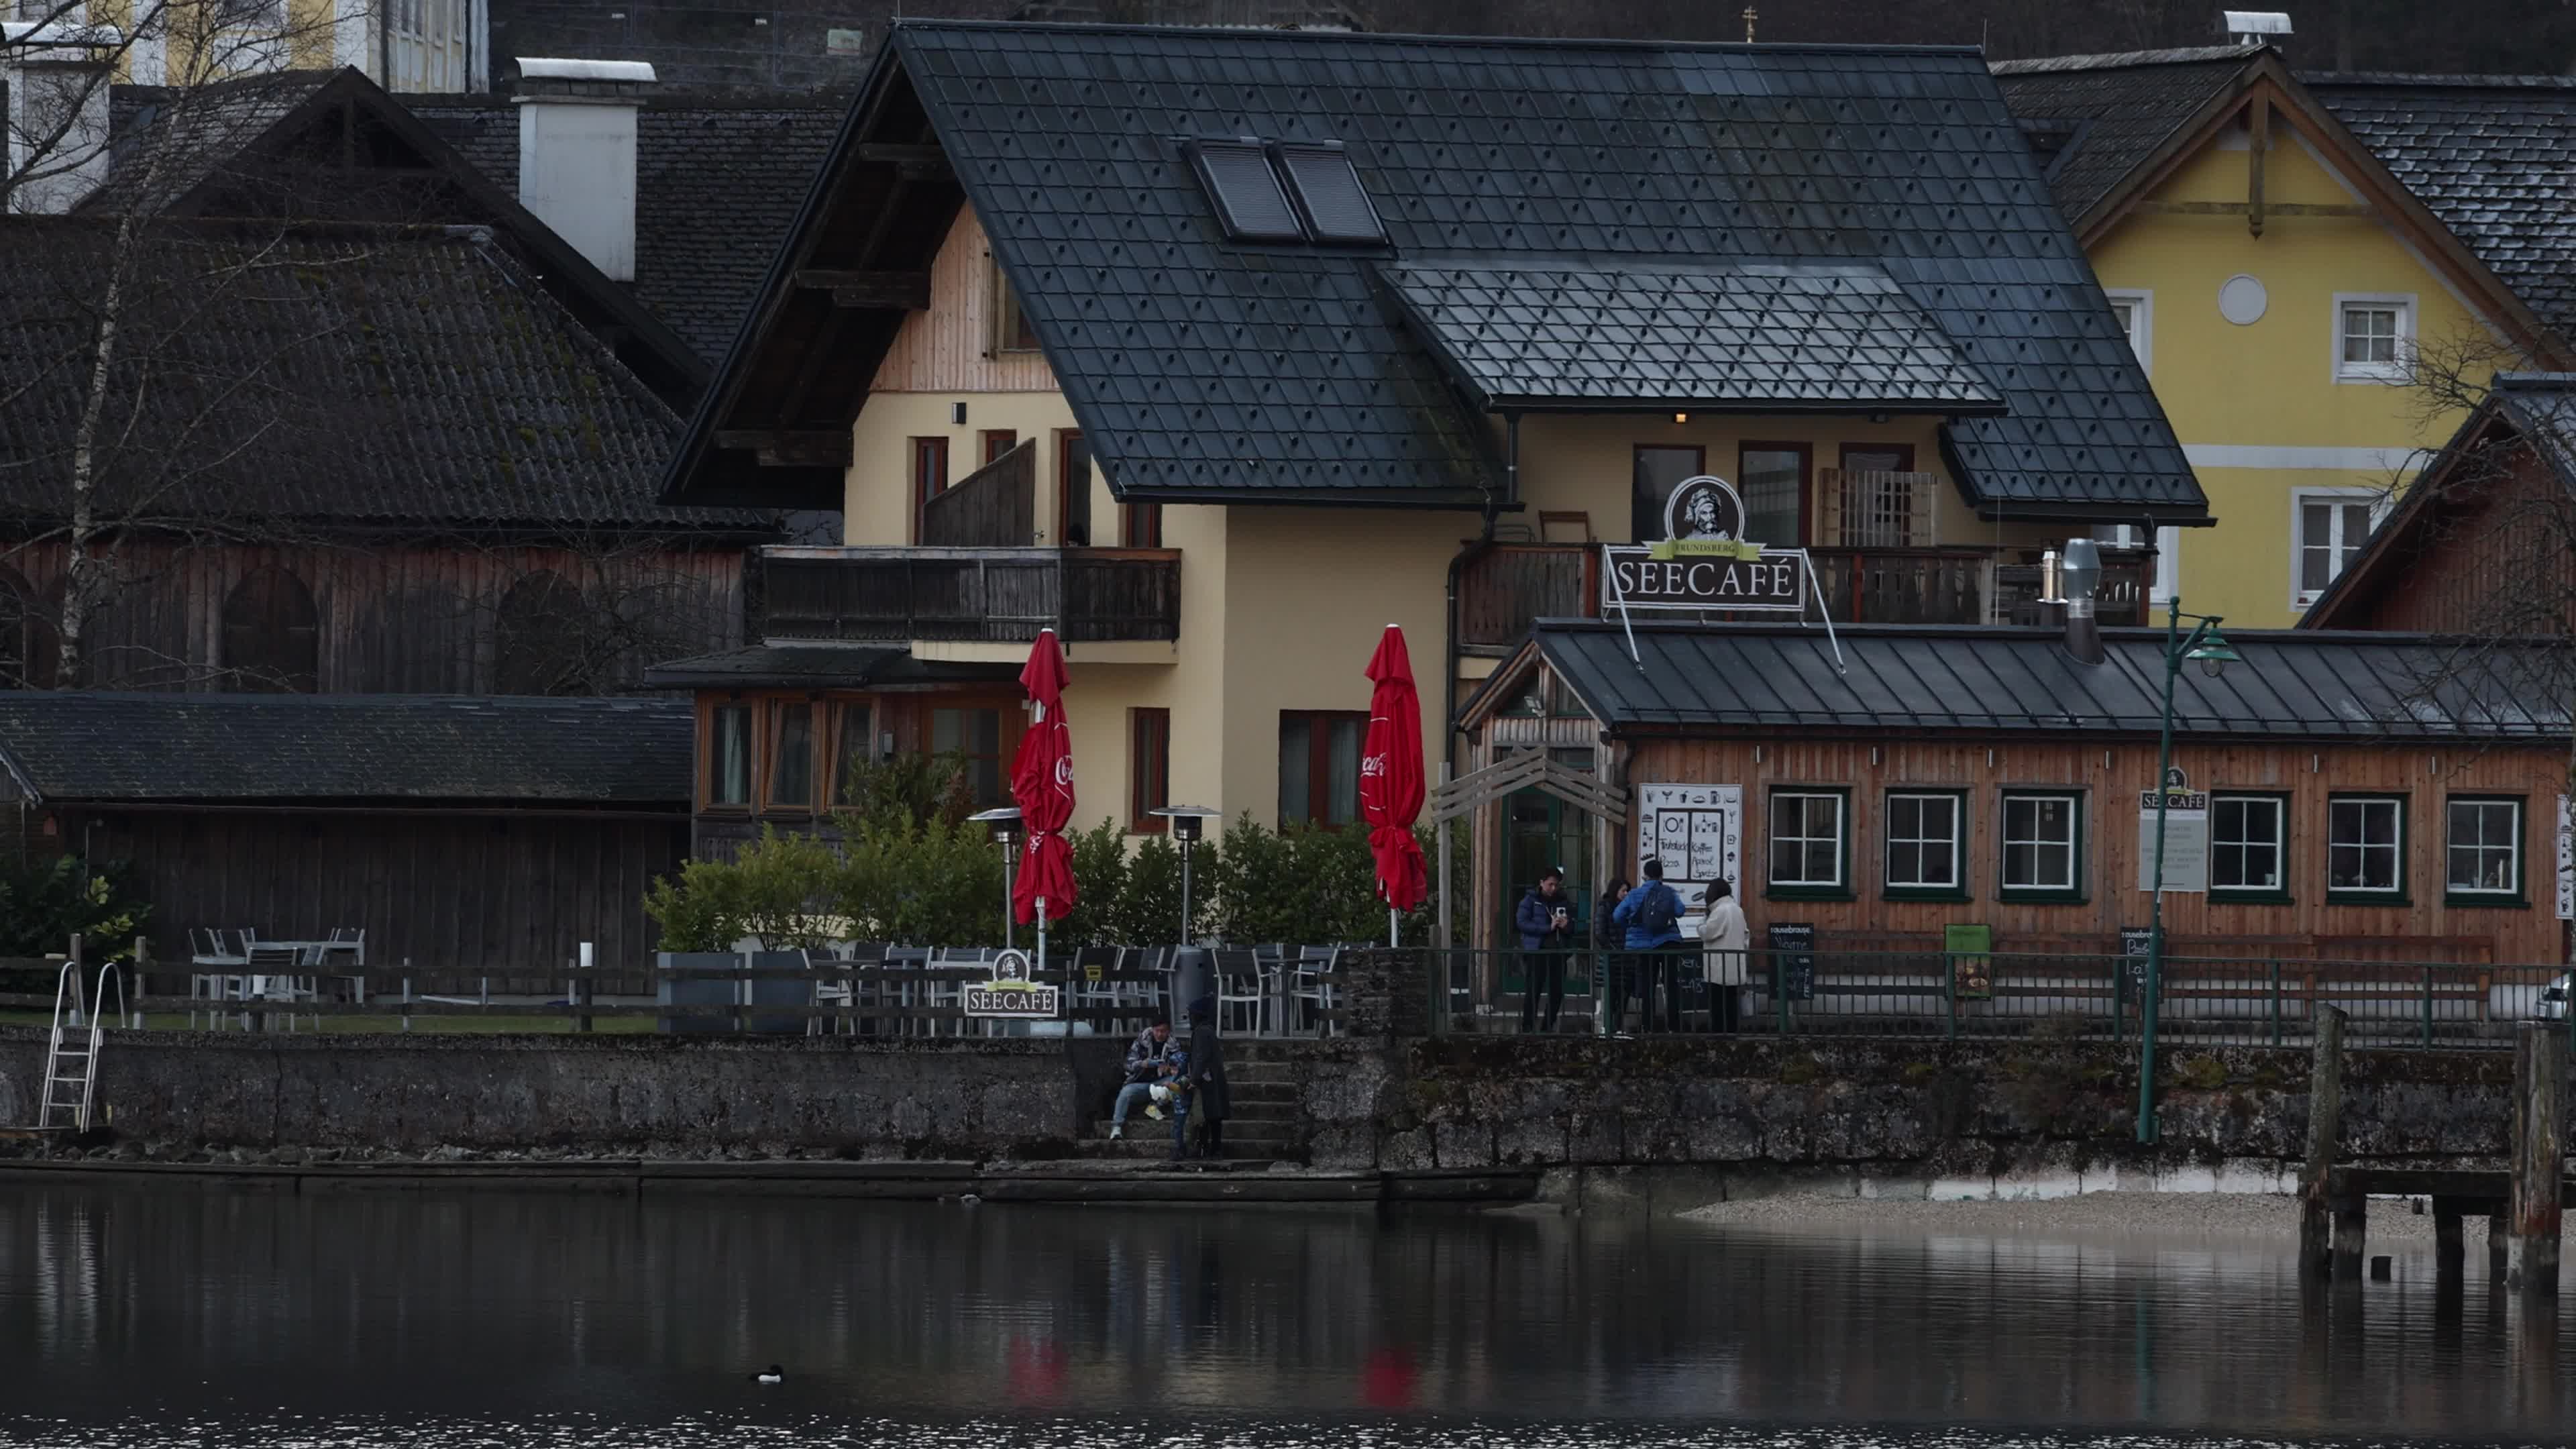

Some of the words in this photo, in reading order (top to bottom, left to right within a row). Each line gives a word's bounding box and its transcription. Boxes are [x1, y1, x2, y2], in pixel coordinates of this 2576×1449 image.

[1674, 543, 1735, 553] FRUNDSBERG
[1618, 558, 1793, 596] SEECAFÉ
[2143, 794, 2204, 808] SECAFÉ
[971, 990, 1052, 1010] SEECAFÉ
